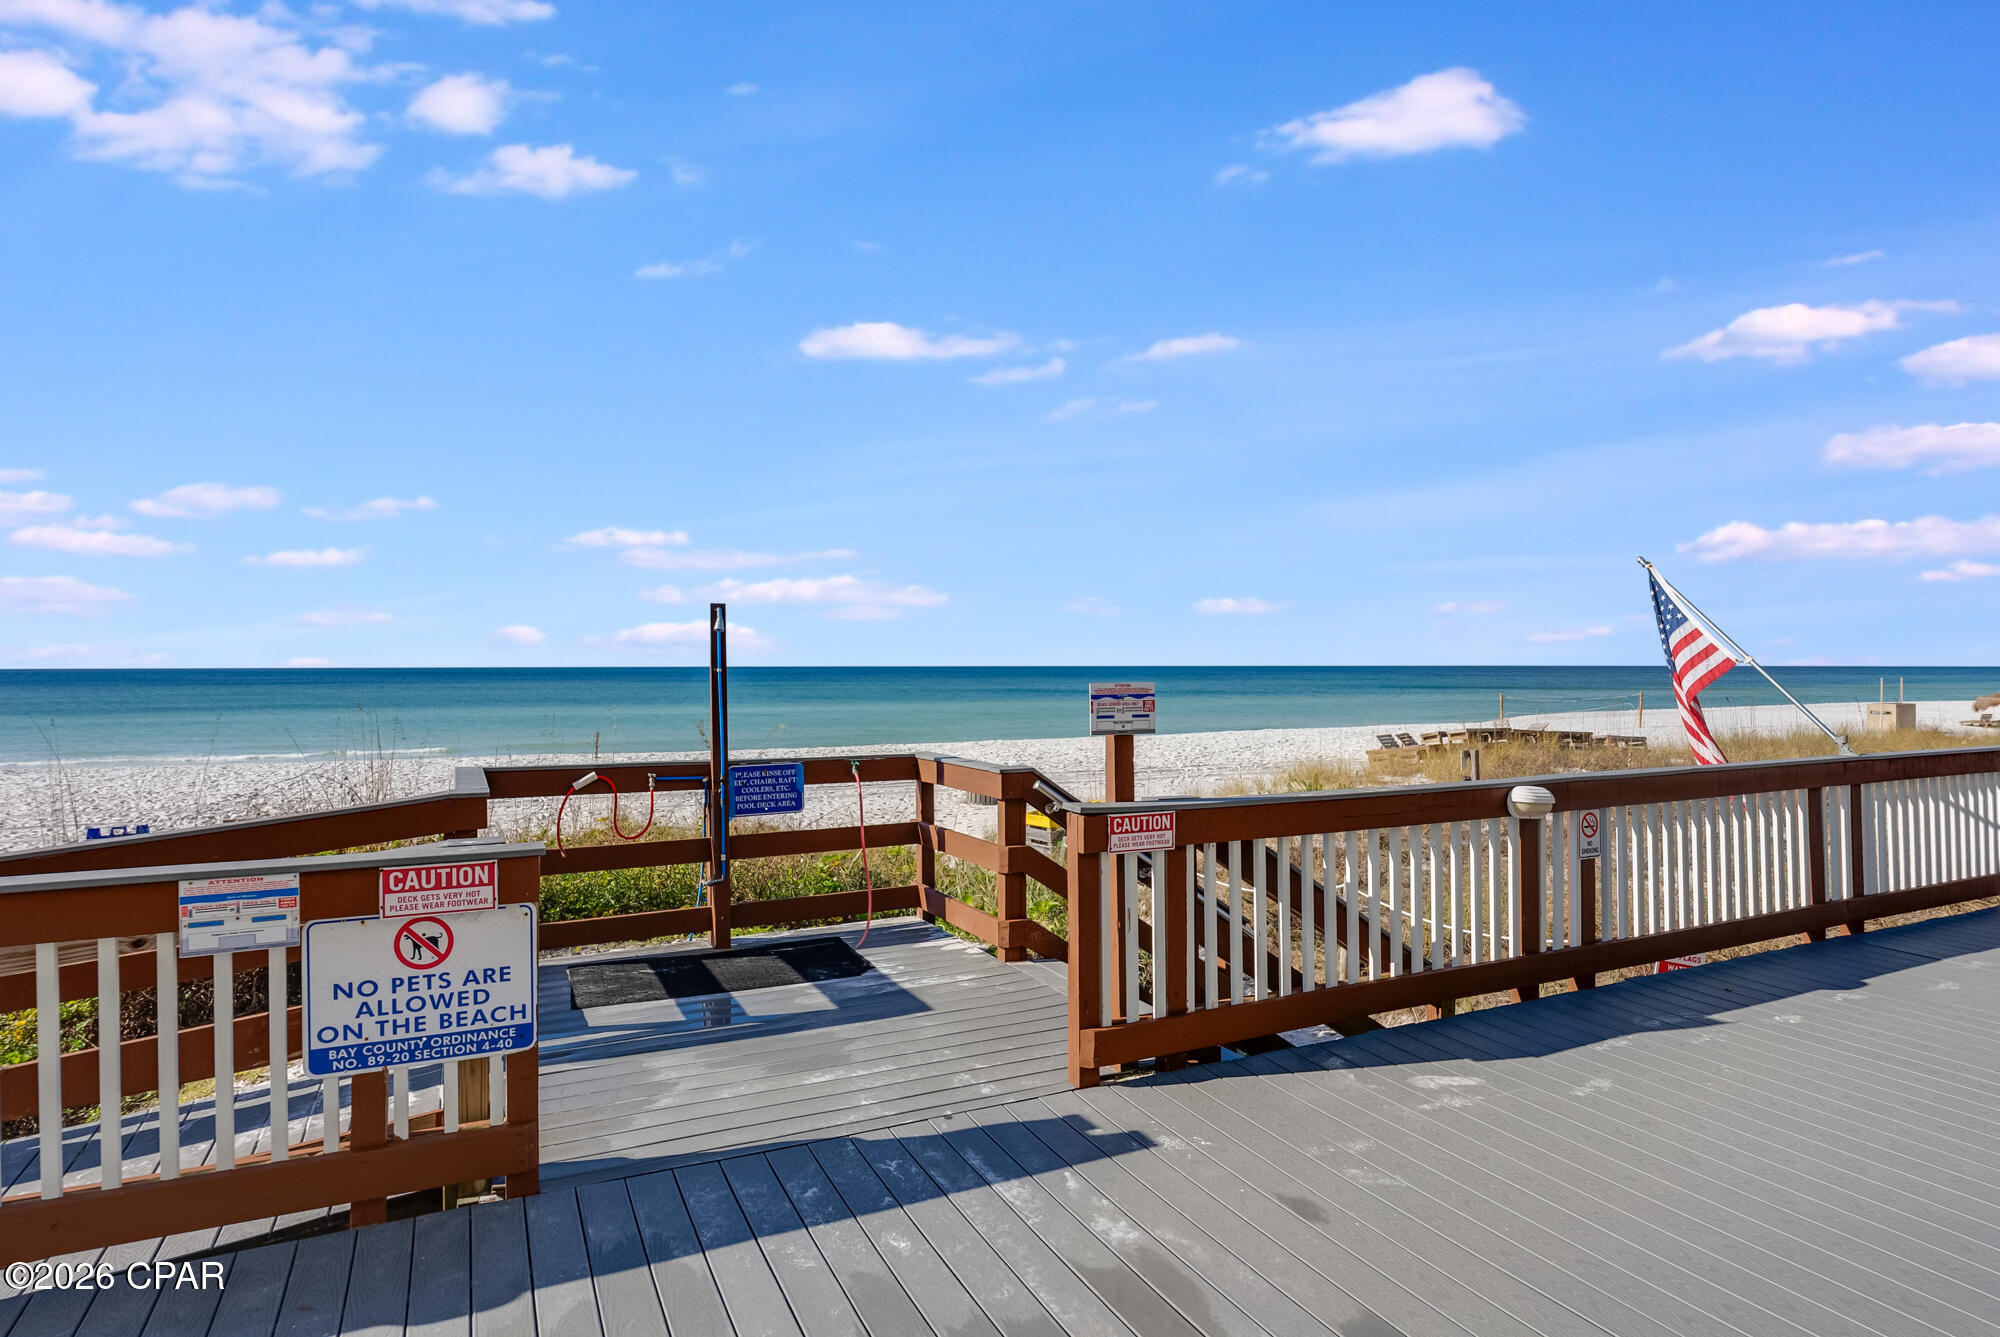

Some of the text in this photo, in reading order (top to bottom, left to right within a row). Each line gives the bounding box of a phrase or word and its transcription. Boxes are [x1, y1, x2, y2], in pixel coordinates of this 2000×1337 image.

[1113, 815, 1170, 832] CAUTION
[208, 877, 264, 885] ATTENTION
[389, 865, 489, 891] CAUTION
[390, 898, 488, 912] PLEASE WEAR FOOTWEAR
[398, 895, 418, 903] DECK
[420, 894, 440, 902] GETS
[466, 890, 480, 898] HOT
[334, 966, 511, 1000] NO PETS ARE
[355, 989, 490, 1019] ALLOWED
[317, 1004, 527, 1043] ON THE BEACH
[329, 1028, 516, 1060] BAY COUNTY ORDINANCE
[332, 1038, 513, 1070] NO. 89-20 SECTION 4-40
